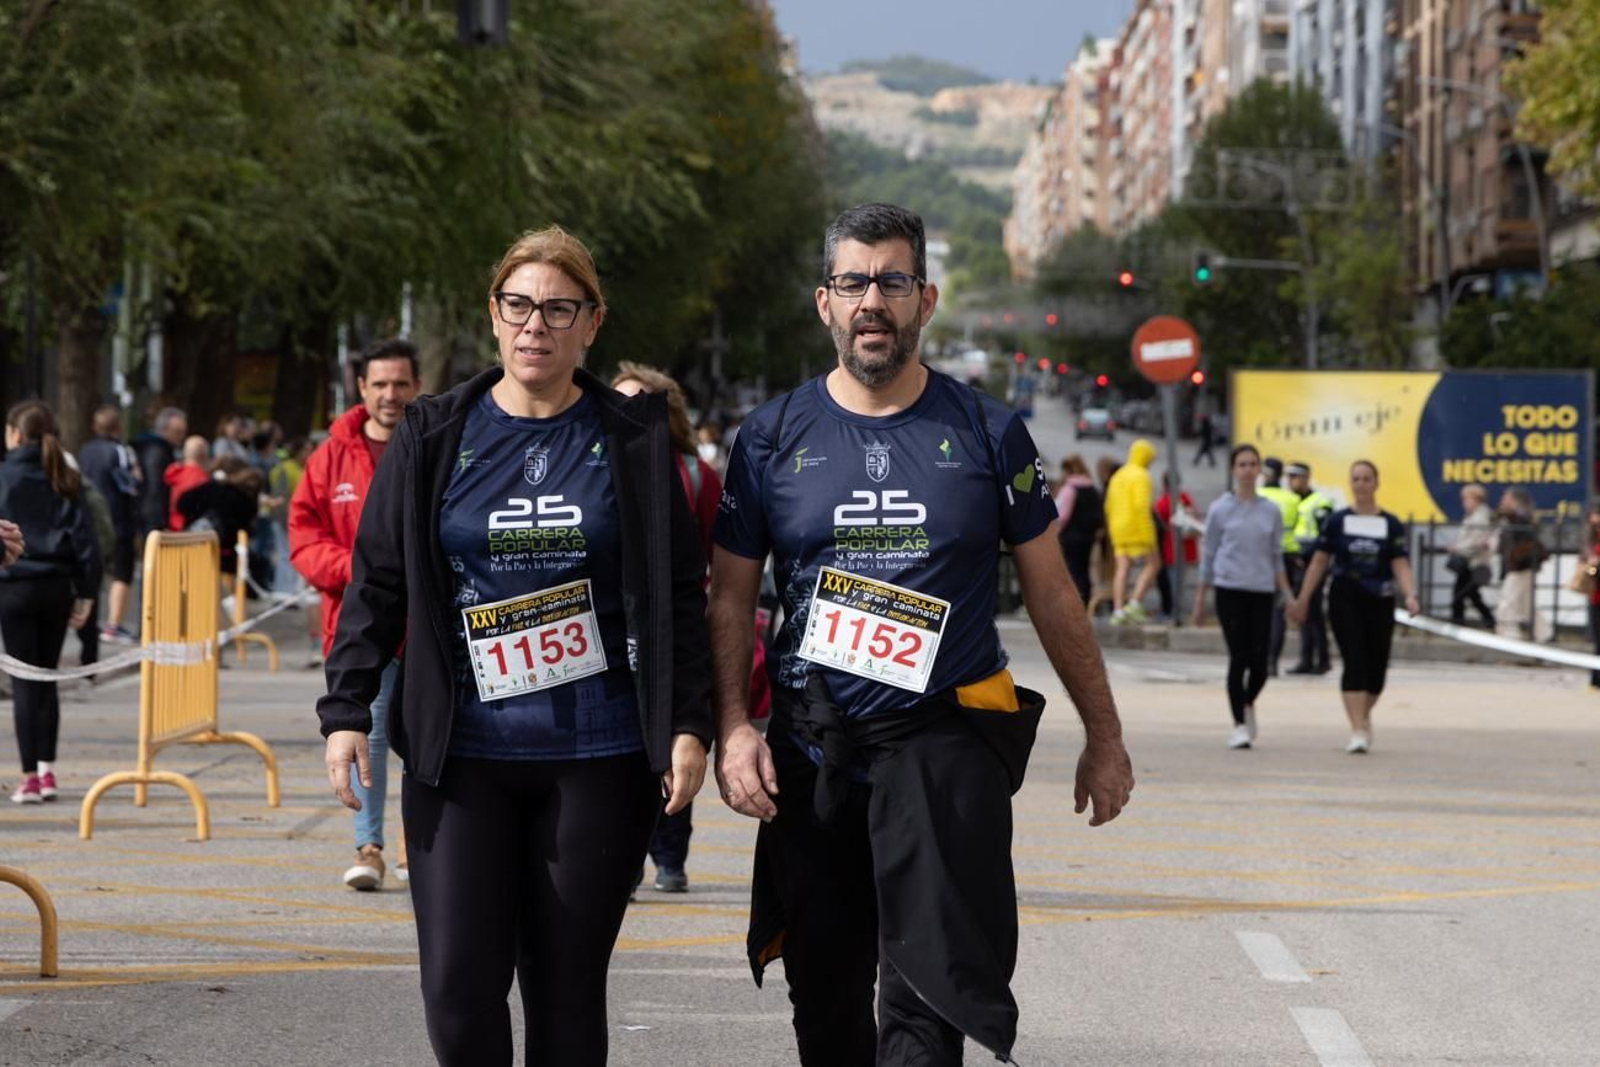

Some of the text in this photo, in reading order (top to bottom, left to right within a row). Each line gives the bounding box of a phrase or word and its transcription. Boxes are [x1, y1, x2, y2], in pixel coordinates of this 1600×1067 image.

[1502, 405, 1578, 429] TODO
[1482, 432, 1578, 456] LO QUE
[1442, 459, 1578, 483] NECESITAS
[488, 494, 583, 529] 25
[834, 490, 927, 526] 25
[488, 527, 583, 541] CARRERA
[834, 526, 927, 538] CARRERA
[490, 539, 587, 552] POPULAR
[490, 550, 587, 562] y gran caminata
[835, 539, 930, 551] POPULAR
[836, 550, 930, 560] y gran caminata
[823, 573, 943, 614] XXV CARRERA POPULAR
[851, 589, 941, 620] y gran caminata
[470, 586, 586, 630] XXV CARRERA POPULAR
[499, 594, 587, 624] y gran caminata
[487, 622, 588, 676] 1153
[825, 609, 923, 669] 1152
